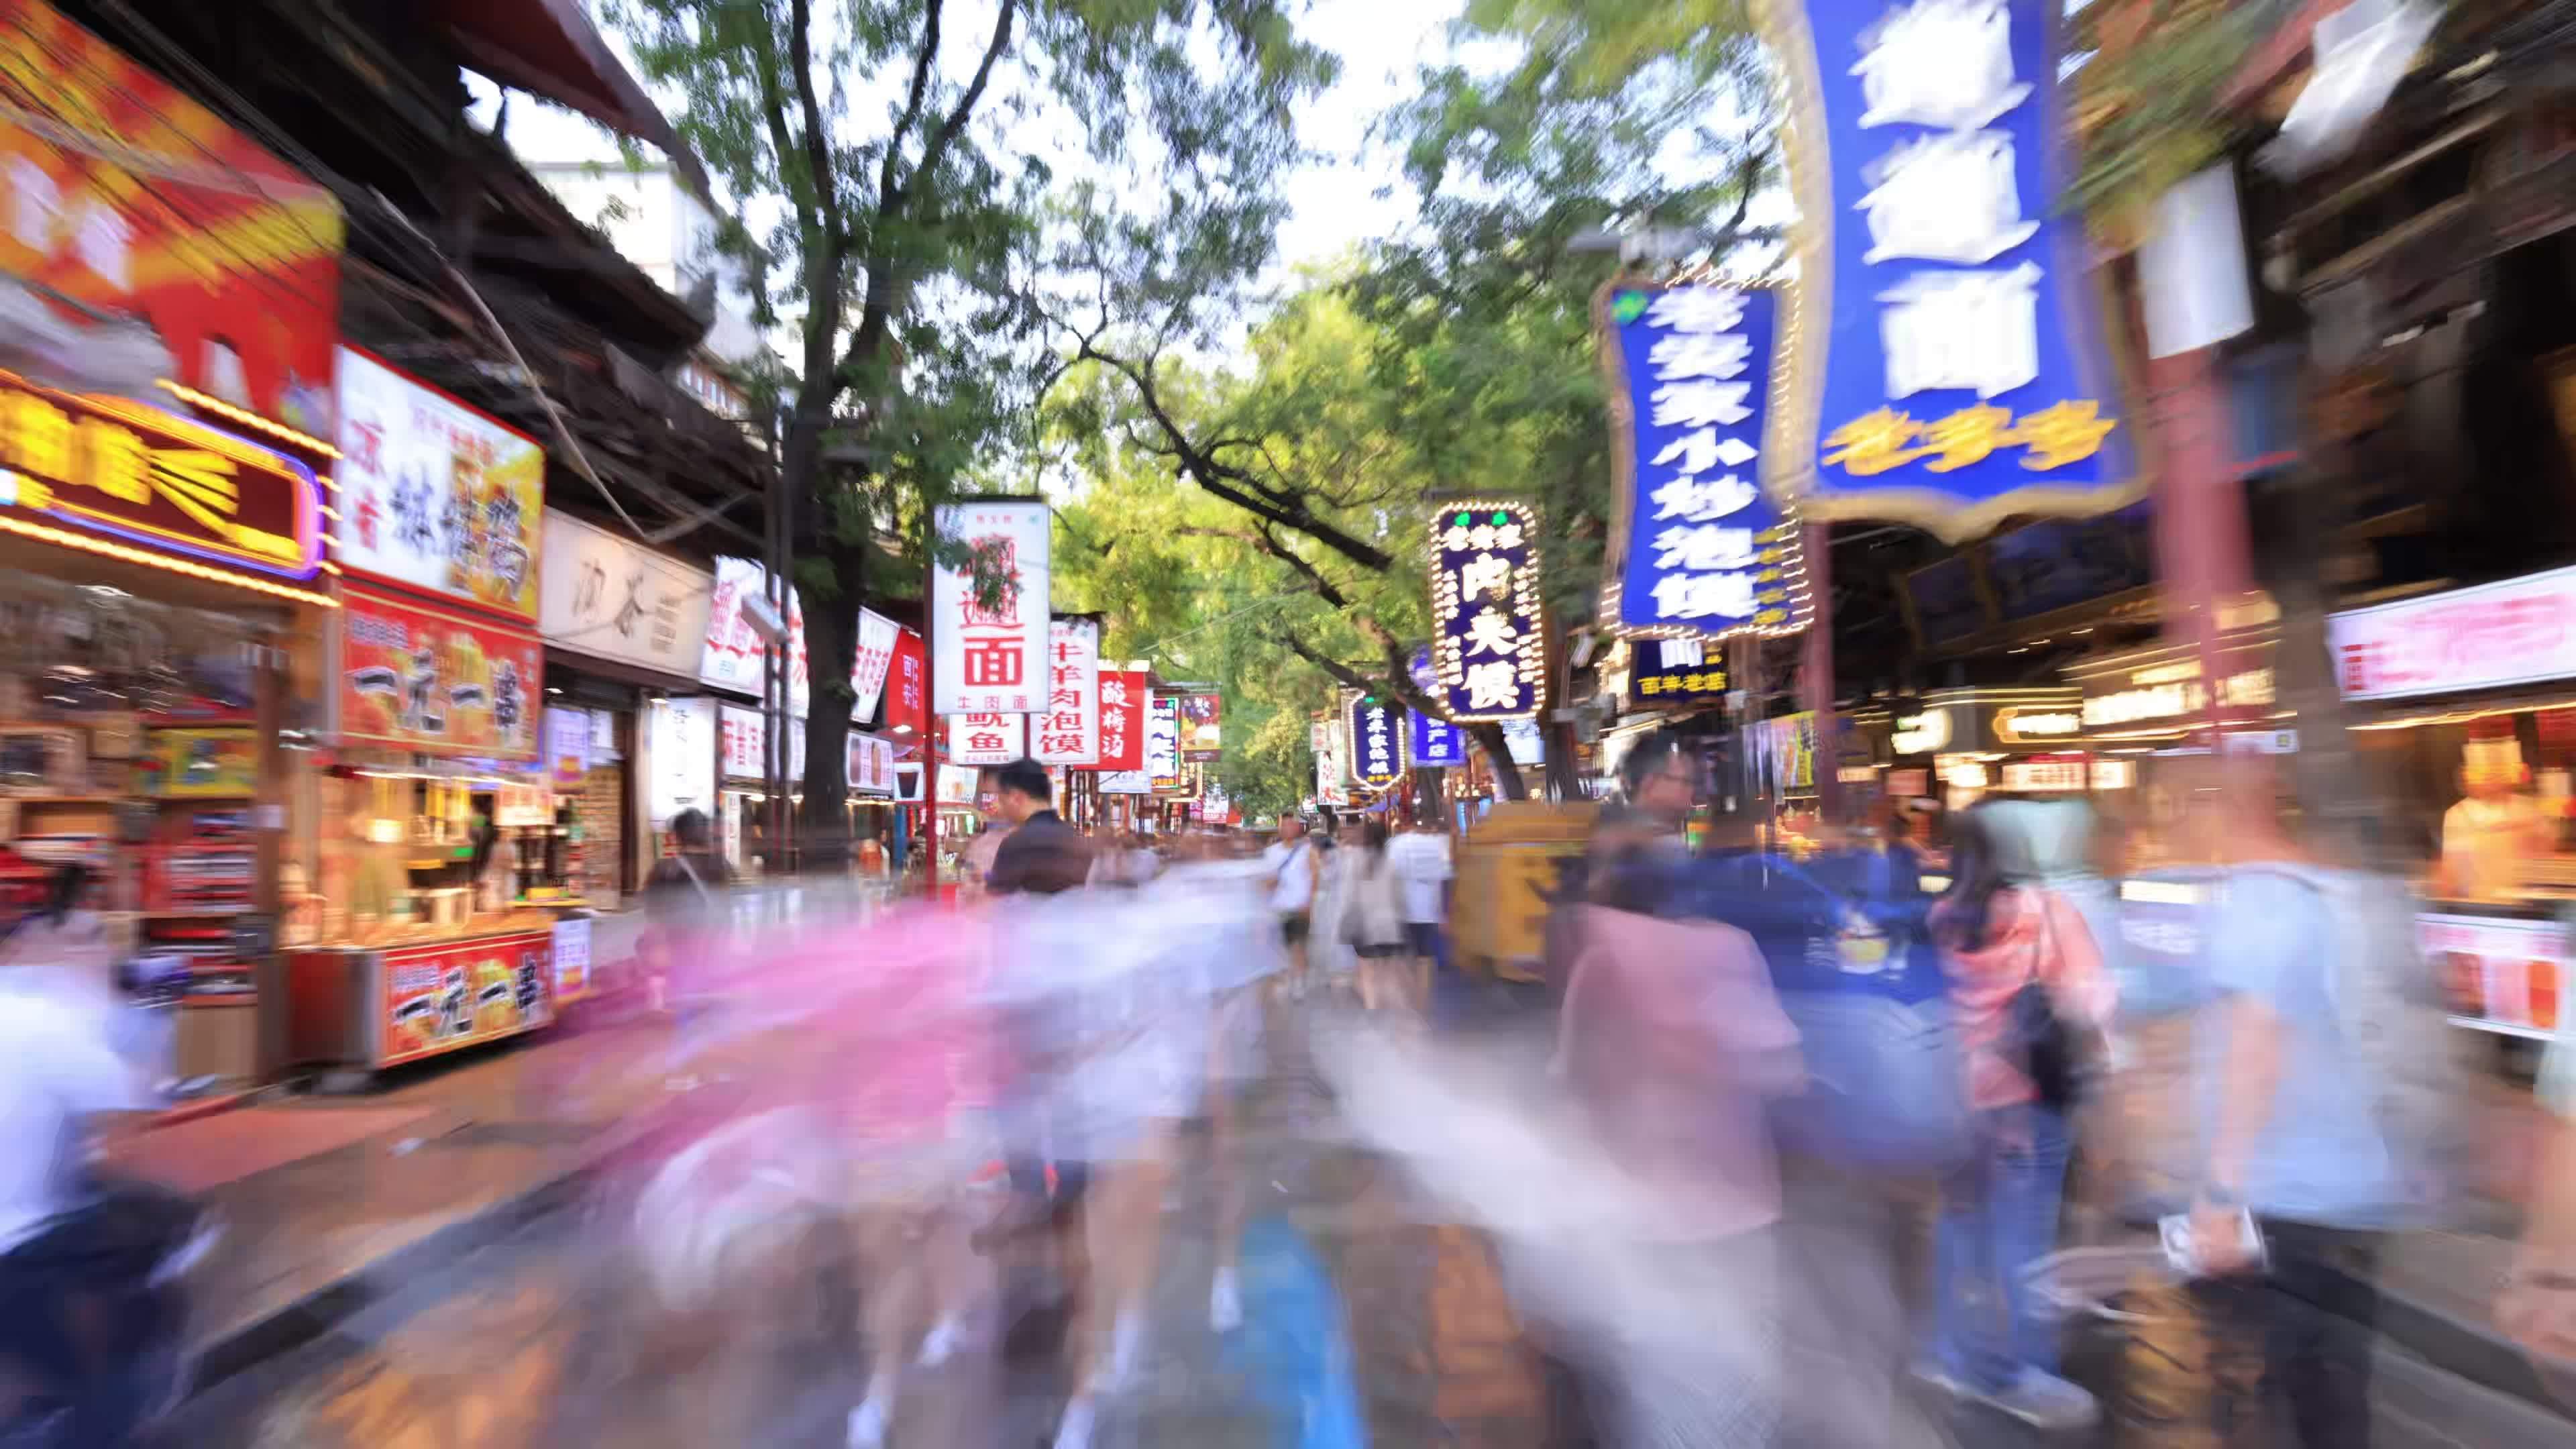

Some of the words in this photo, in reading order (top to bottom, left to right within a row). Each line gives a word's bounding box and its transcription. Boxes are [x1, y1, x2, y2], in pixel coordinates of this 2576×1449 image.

[1039, 642, 1085, 754] 牛羊肉泡馍
[1100, 680, 1136, 759] 酸梅汤
